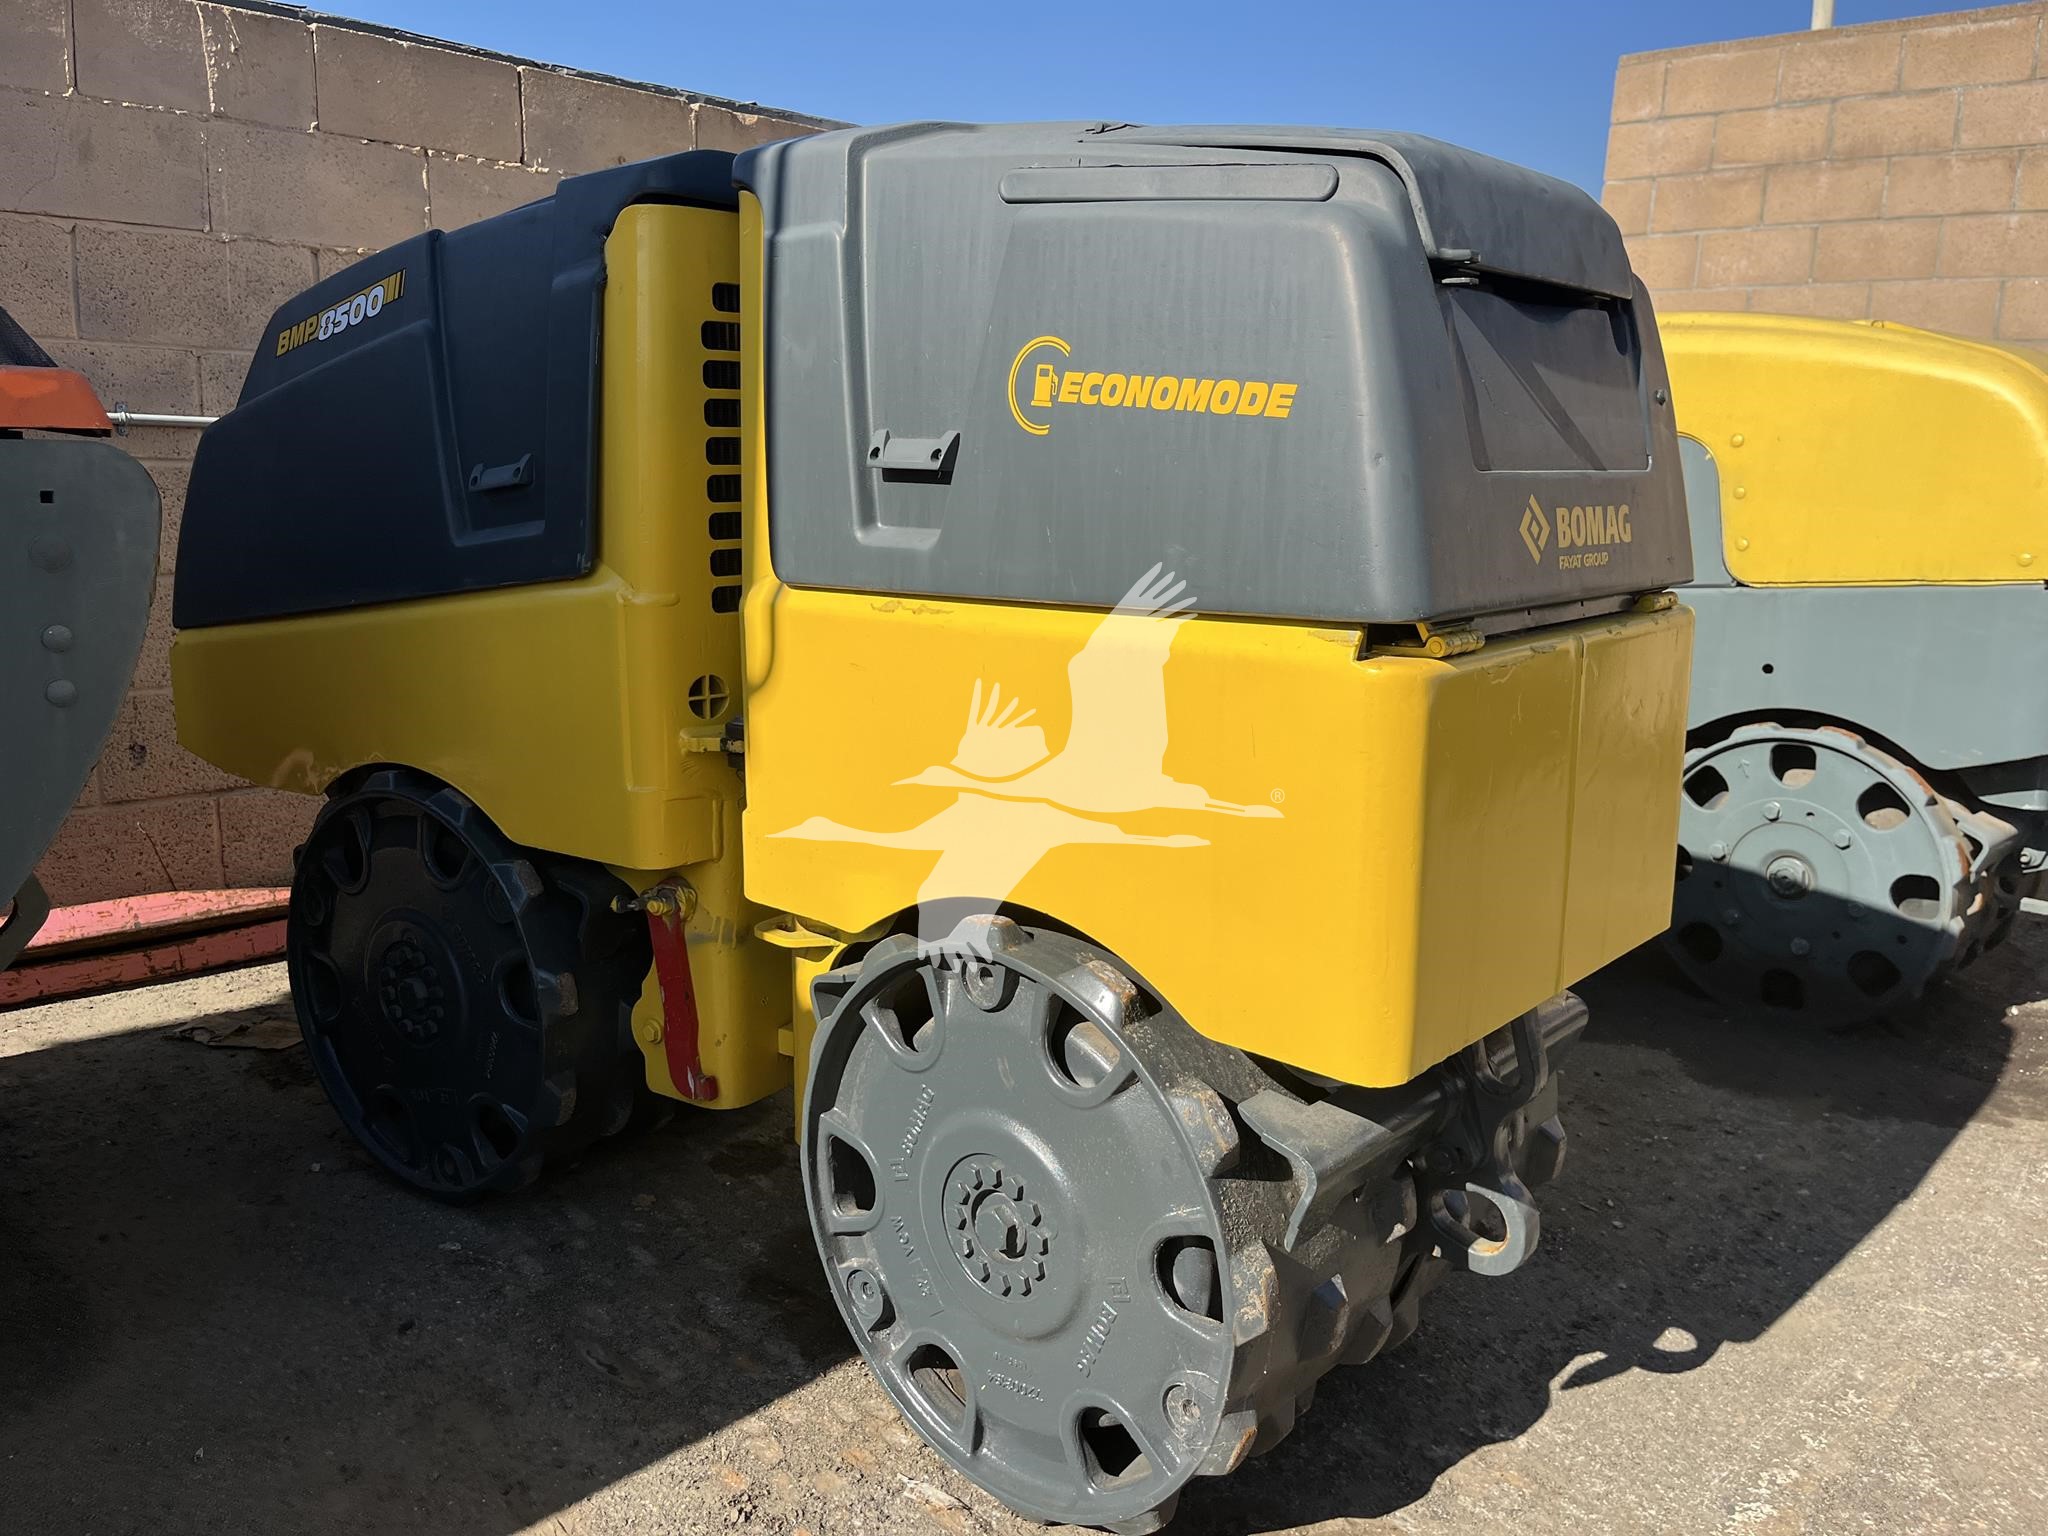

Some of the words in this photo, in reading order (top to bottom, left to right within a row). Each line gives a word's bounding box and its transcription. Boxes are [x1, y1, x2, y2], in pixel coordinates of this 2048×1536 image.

[1058, 371, 1298, 418] ECONOMODE
[1556, 504, 1632, 548] BOMAG
[1560, 554, 1582, 570] FAYAT
[1583, 552, 1609, 567] GROUP
